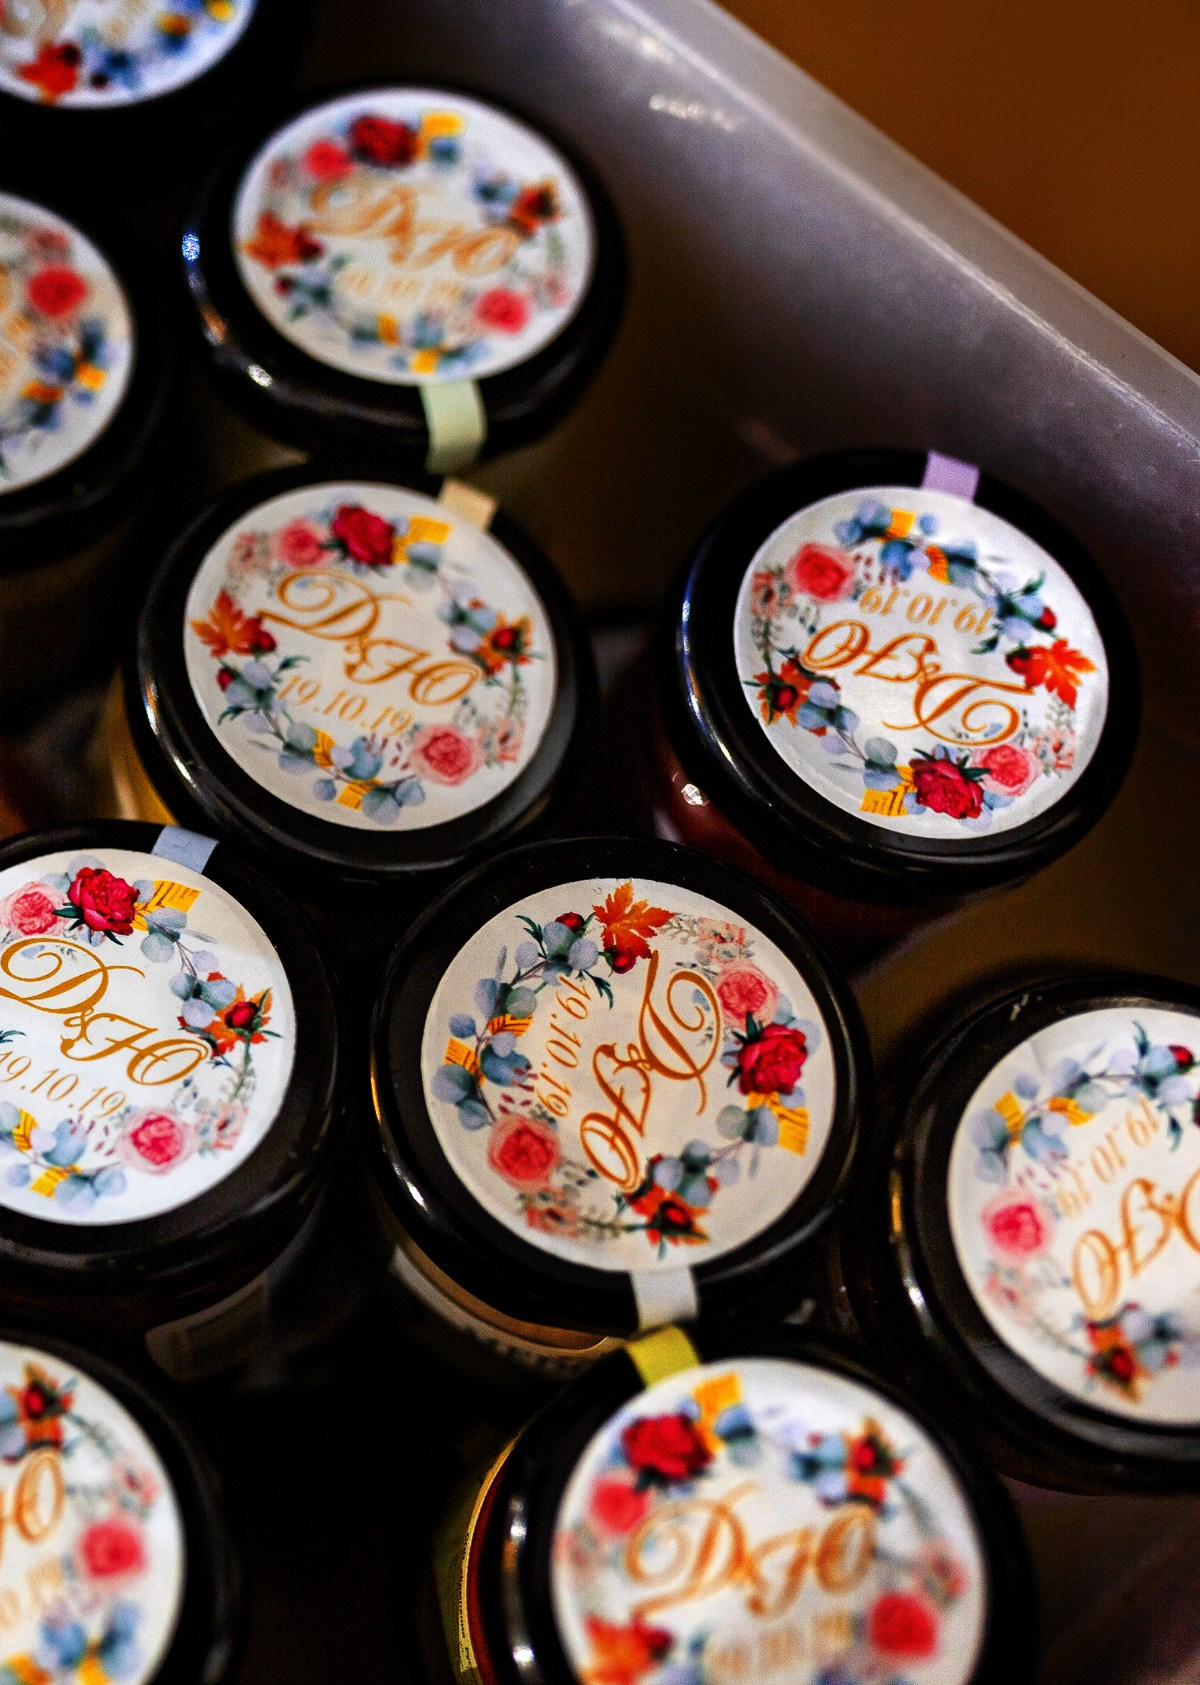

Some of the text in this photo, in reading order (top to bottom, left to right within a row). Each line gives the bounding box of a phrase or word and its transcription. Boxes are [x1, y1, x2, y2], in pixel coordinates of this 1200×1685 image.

[859, 584, 996, 636] 19.10.19
[277, 673, 415, 740] 19.10.19
[536, 974, 595, 1119] 19.10.19
